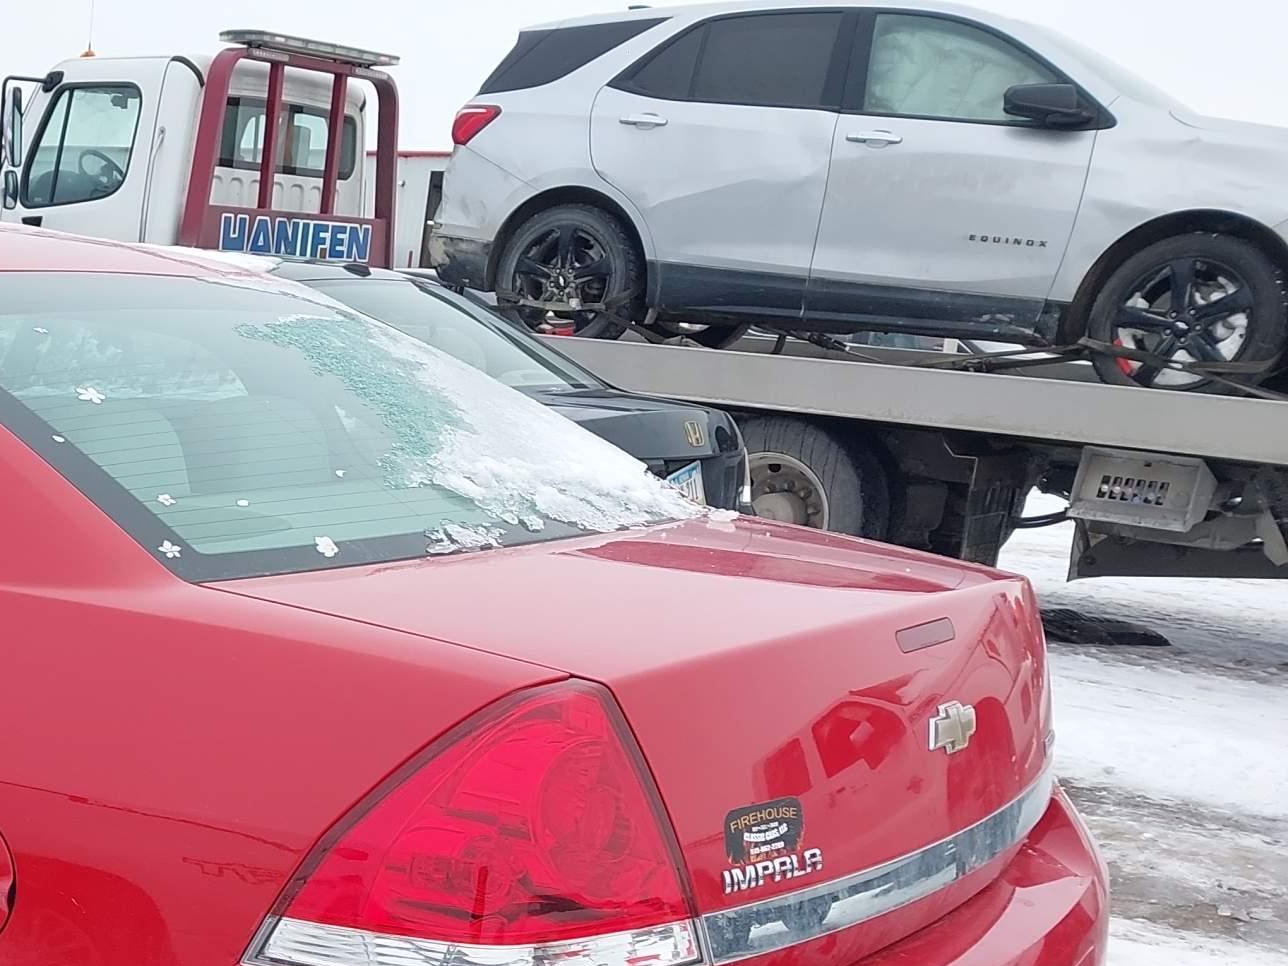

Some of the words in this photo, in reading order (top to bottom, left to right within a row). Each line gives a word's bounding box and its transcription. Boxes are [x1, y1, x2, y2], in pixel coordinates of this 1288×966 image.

[220, 213, 372, 262] HANIFEN
[968, 234, 1048, 248] EQUINOX
[730, 807, 798, 833] FIREHOUSE
[723, 848, 823, 895] IMPALA
